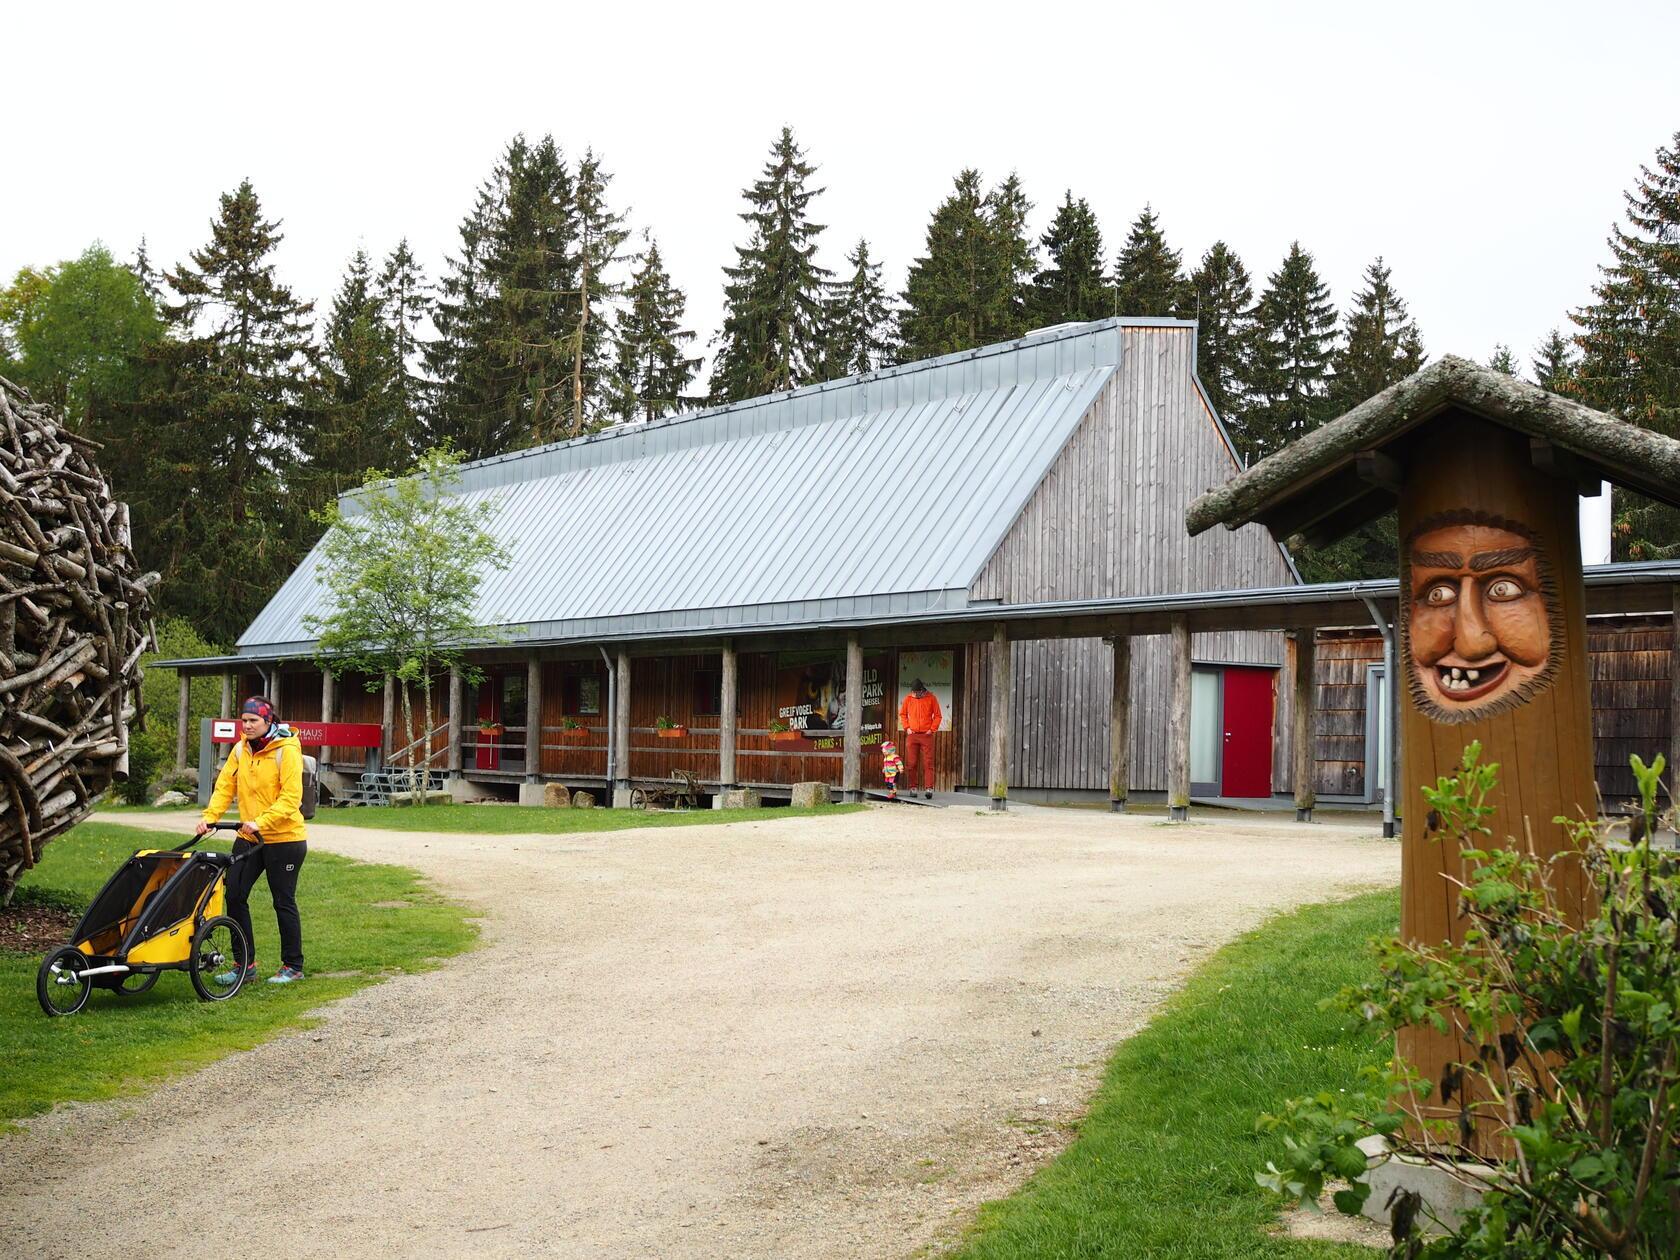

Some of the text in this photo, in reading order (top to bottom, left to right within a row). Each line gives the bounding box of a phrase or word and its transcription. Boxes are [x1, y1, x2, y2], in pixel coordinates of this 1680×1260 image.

[863, 668, 878, 683] ILD
[862, 682, 884, 698] PARK
[779, 704, 813, 718] GREIFVOGEL
[789, 715, 808, 730] PARK
[300, 728, 323, 737] HAUS
[813, 740, 818, 750] 2
[818, 738, 834, 750] PARKS
[860, 733, 882, 746] SCHAFT!
